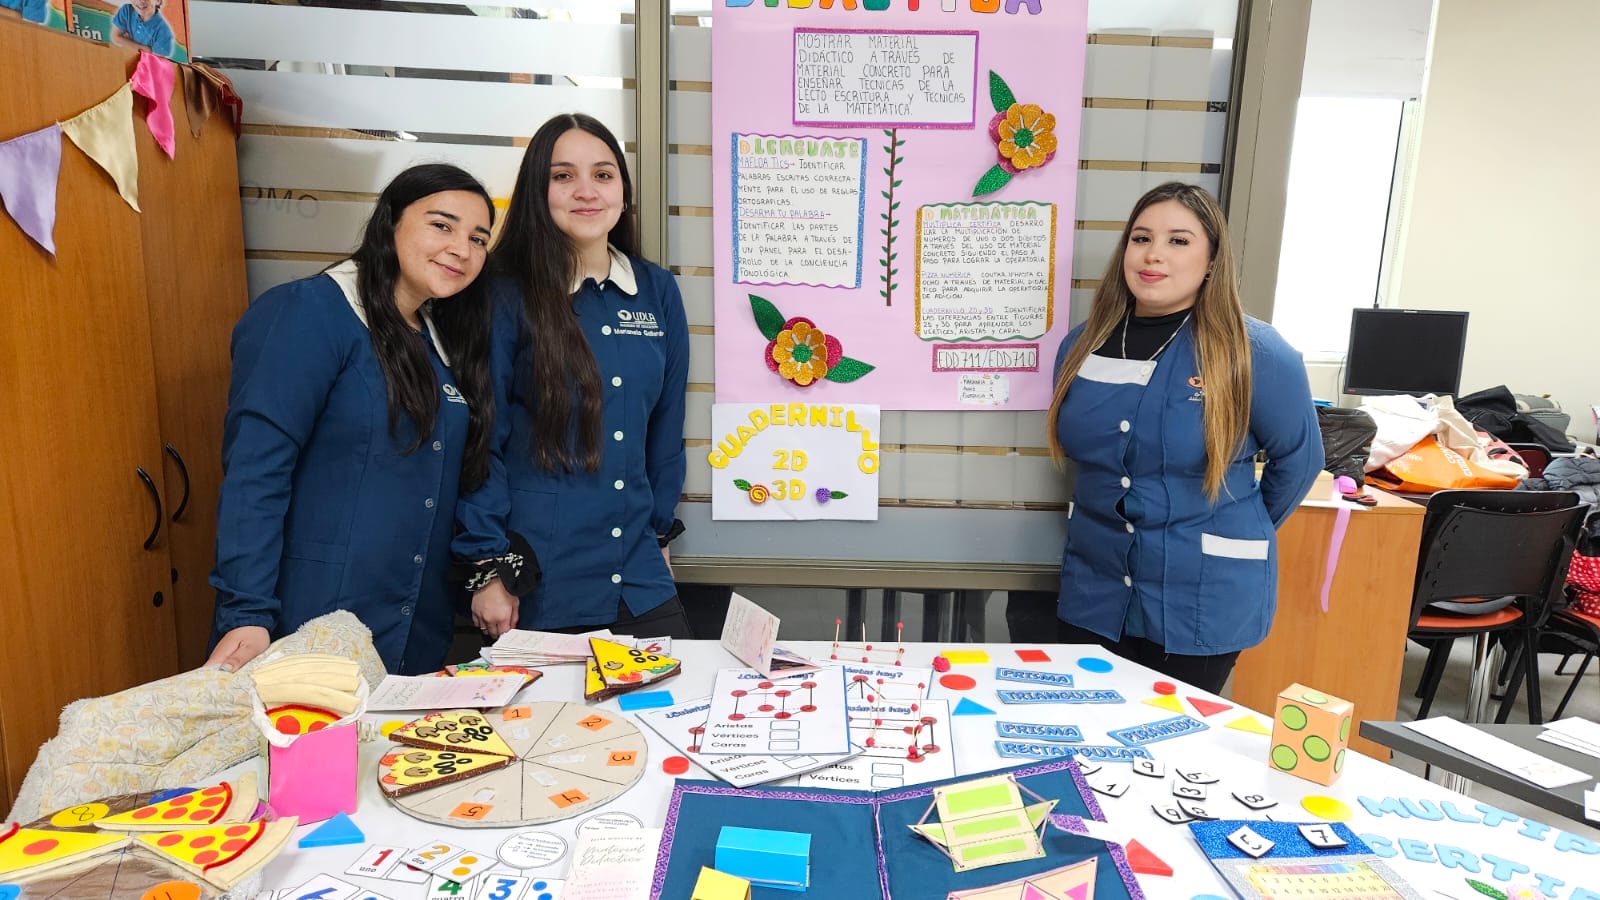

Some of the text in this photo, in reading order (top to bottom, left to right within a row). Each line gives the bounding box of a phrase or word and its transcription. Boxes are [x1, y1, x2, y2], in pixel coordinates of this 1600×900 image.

[797, 34, 918, 49] MOSTRAR MATERIAL
[870, 52, 877, 63] A
[943, 53, 955, 64] DE
[797, 64, 950, 80] MATERIAL CONCRETO PARA
[859, 78, 904, 91] TECNICAS
[919, 80, 930, 91] DE
[943, 80, 954, 91] LA
[798, 90, 827, 101] LECTO
[835, 91, 889, 102] ESCRITURA
[924, 92, 965, 103] TECNICAS
[799, 103, 810, 113] DE
[818, 103, 829, 113] LA
[799, 159, 845, 170] IDENTIFICAR
[767, 186, 783, 194] PARA
[739, 220, 785, 230] IDENTIFICAR
[793, 222, 804, 230] LAS
[765, 234, 797, 242] PALABRA
[760, 247, 781, 255] PANEL
[707, 402, 880, 474] CUADERNILLO
[772, 449, 808, 472] 2D
[771, 478, 807, 500] 3D
[1001, 668, 1070, 683] PRISMA
[1006, 691, 1118, 700] TRIANGULAR
[511, 708, 521, 719] 1
[585, 718, 603, 727] 2
[1003, 723, 1079, 737] PRISMA
[1002, 743, 1148, 759] RECTANGULAR
[709, 755, 747, 765] Arista
[734, 768, 769, 780] Caras
[1180, 786, 1201, 796] 3
[562, 794, 580, 803] 4
[1244, 794, 1264, 803] 8
[72, 806, 95, 822] 8
[462, 806, 483, 817] 5
[1310, 829, 1329, 843] 7
[372, 848, 394, 866] 1
[417, 845, 450, 860] 2
[412, 857, 426, 865] dos
[437, 880, 463, 895] 4
[488, 879, 518, 900] 3
